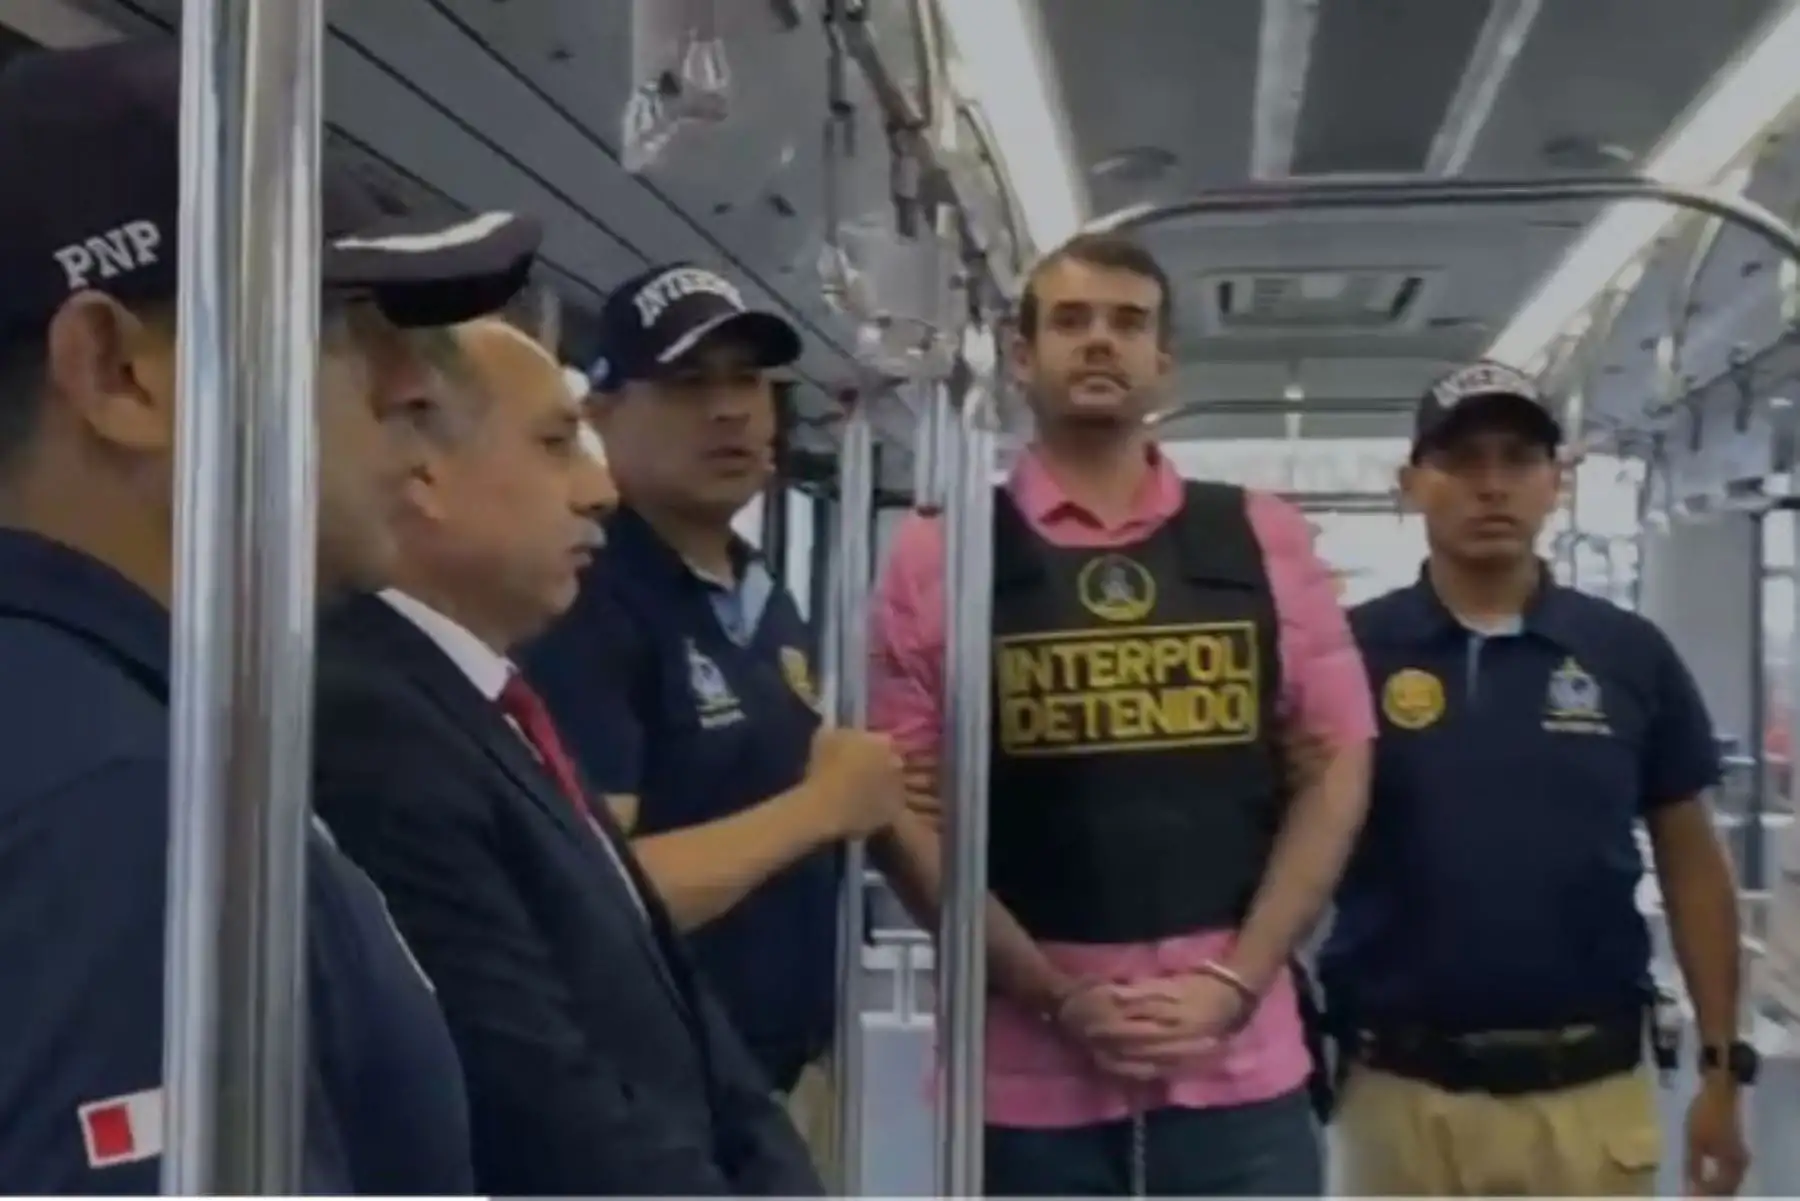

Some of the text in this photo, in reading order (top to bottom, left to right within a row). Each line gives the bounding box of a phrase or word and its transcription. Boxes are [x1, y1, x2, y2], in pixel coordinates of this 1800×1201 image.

[52, 219, 161, 290] PNP
[1001, 635, 1251, 691] INTERPOL
[1003, 684, 1250, 742] DETENIDO
